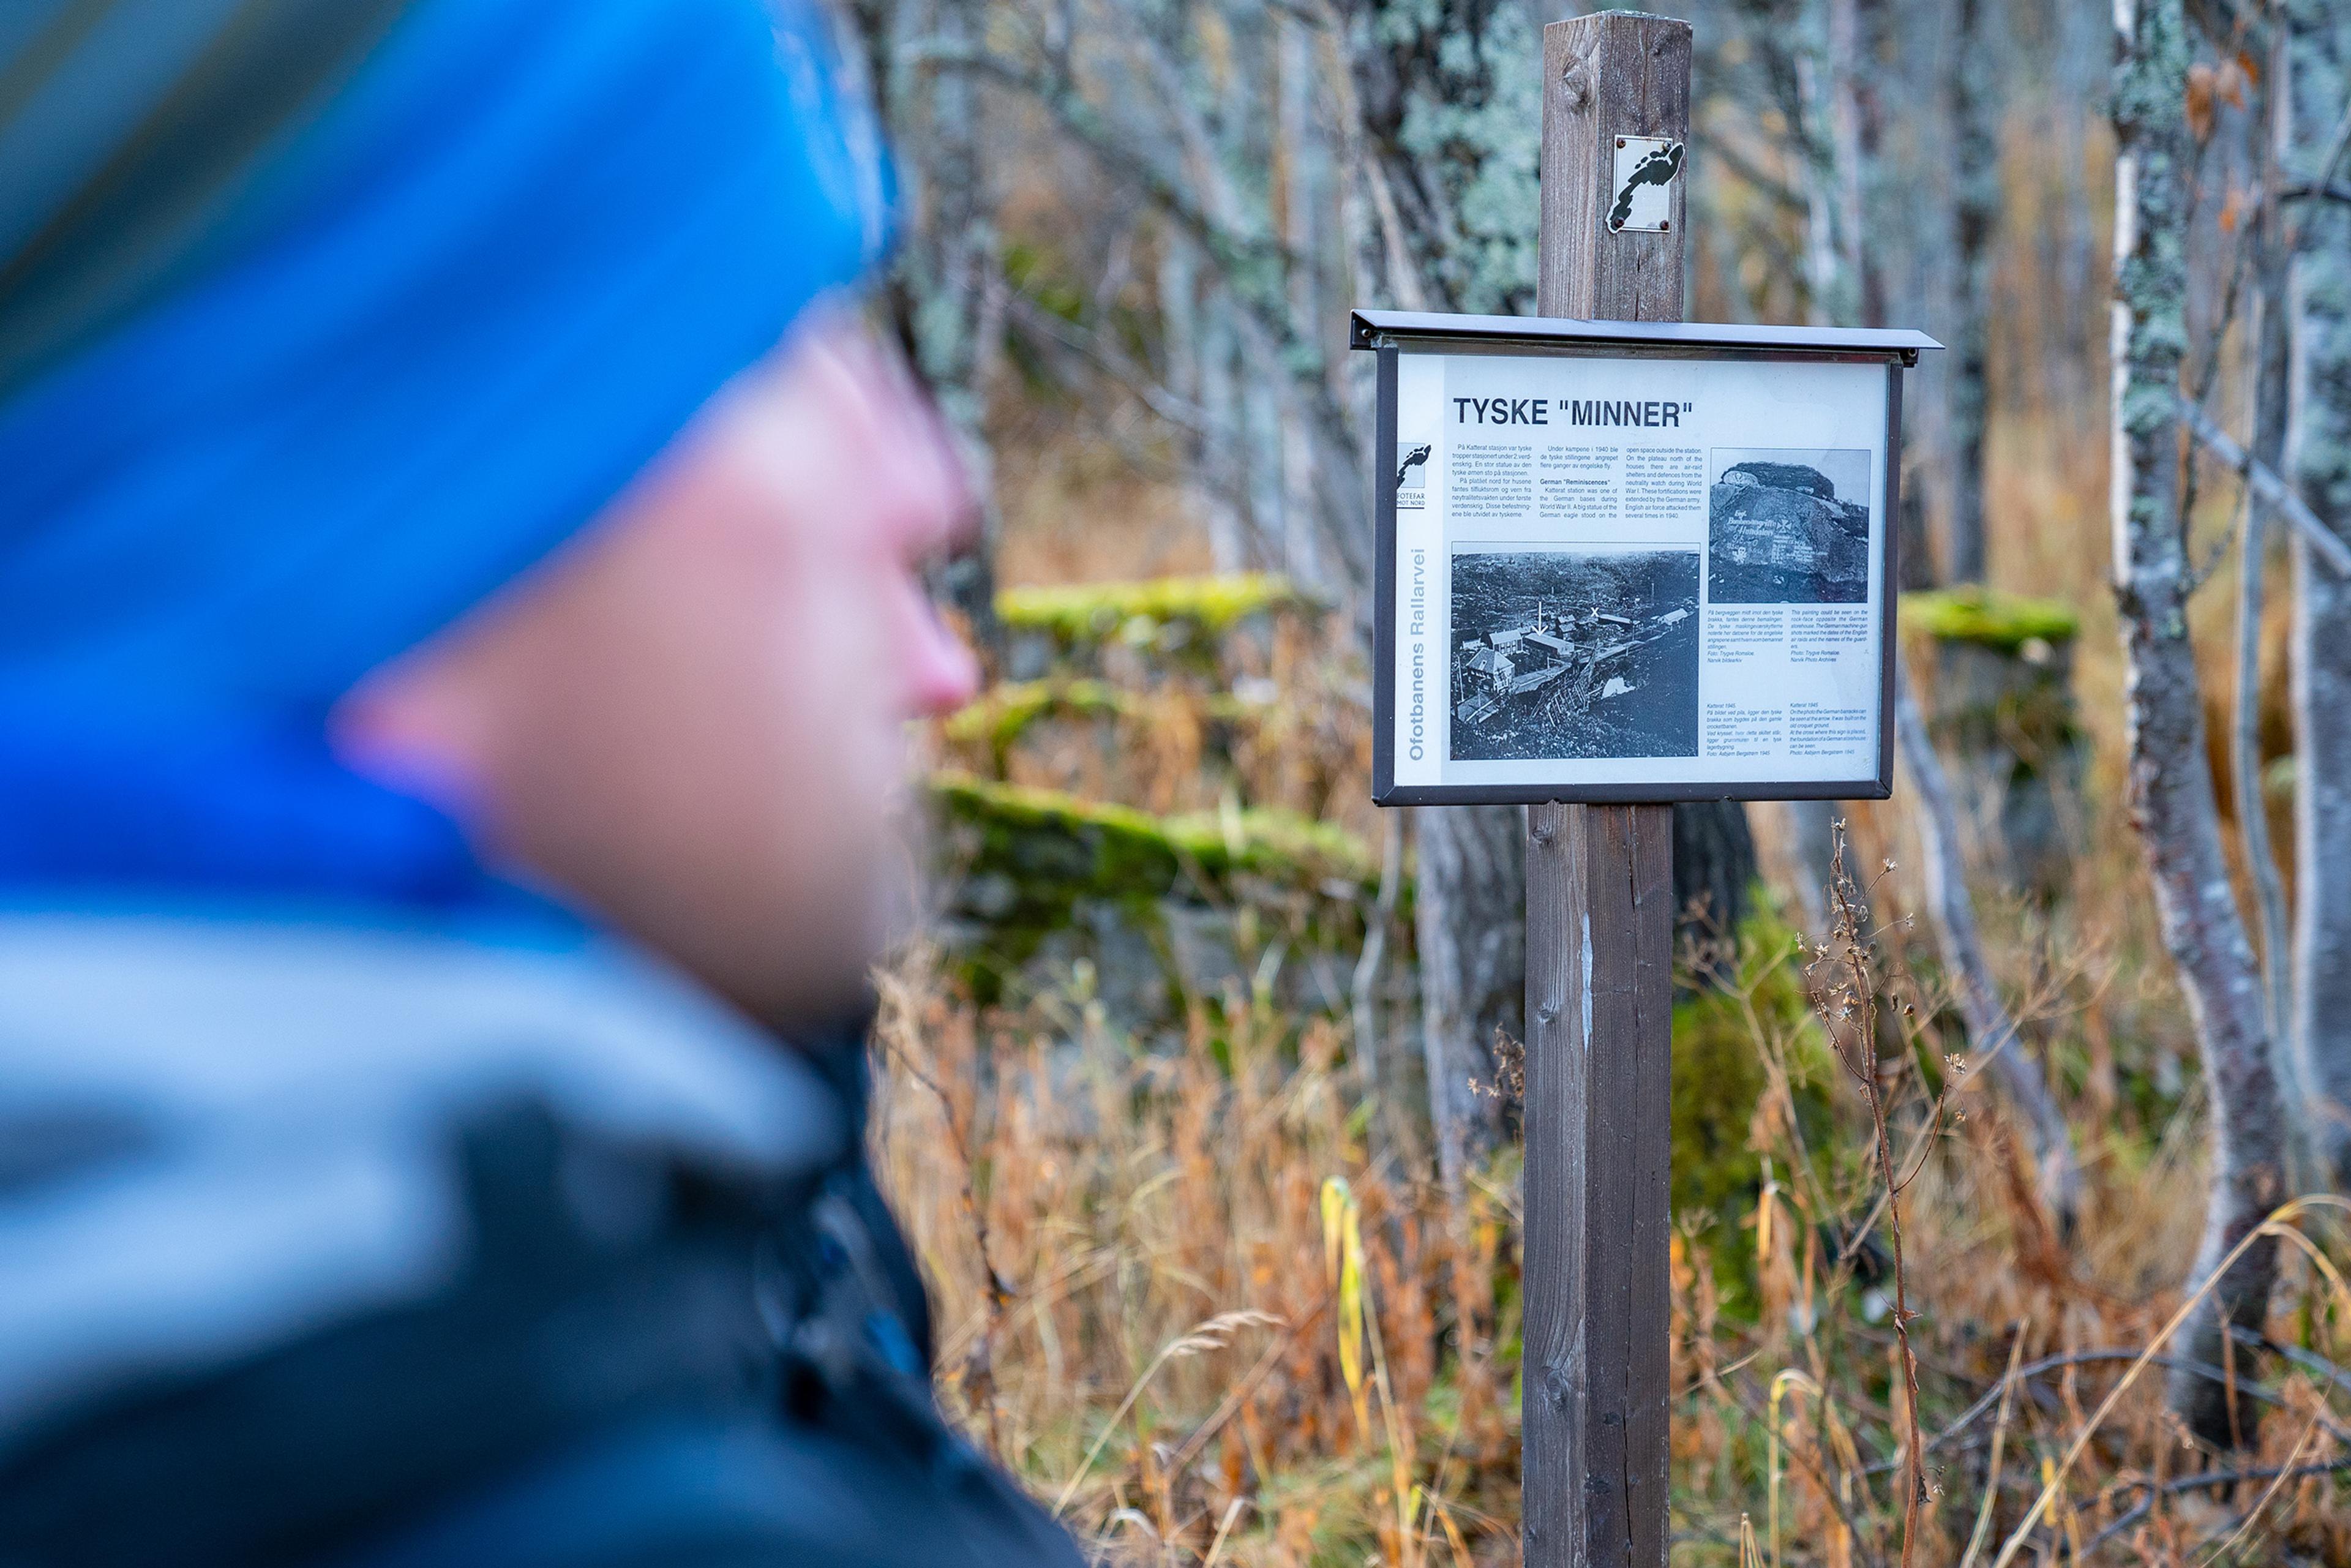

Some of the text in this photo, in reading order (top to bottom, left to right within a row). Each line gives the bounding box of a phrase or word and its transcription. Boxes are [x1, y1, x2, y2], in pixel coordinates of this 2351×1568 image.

[1453, 398, 1692, 427] TYSKE "MINNER"
[1409, 549, 1425, 761] Ofotbanens Rallarvei
